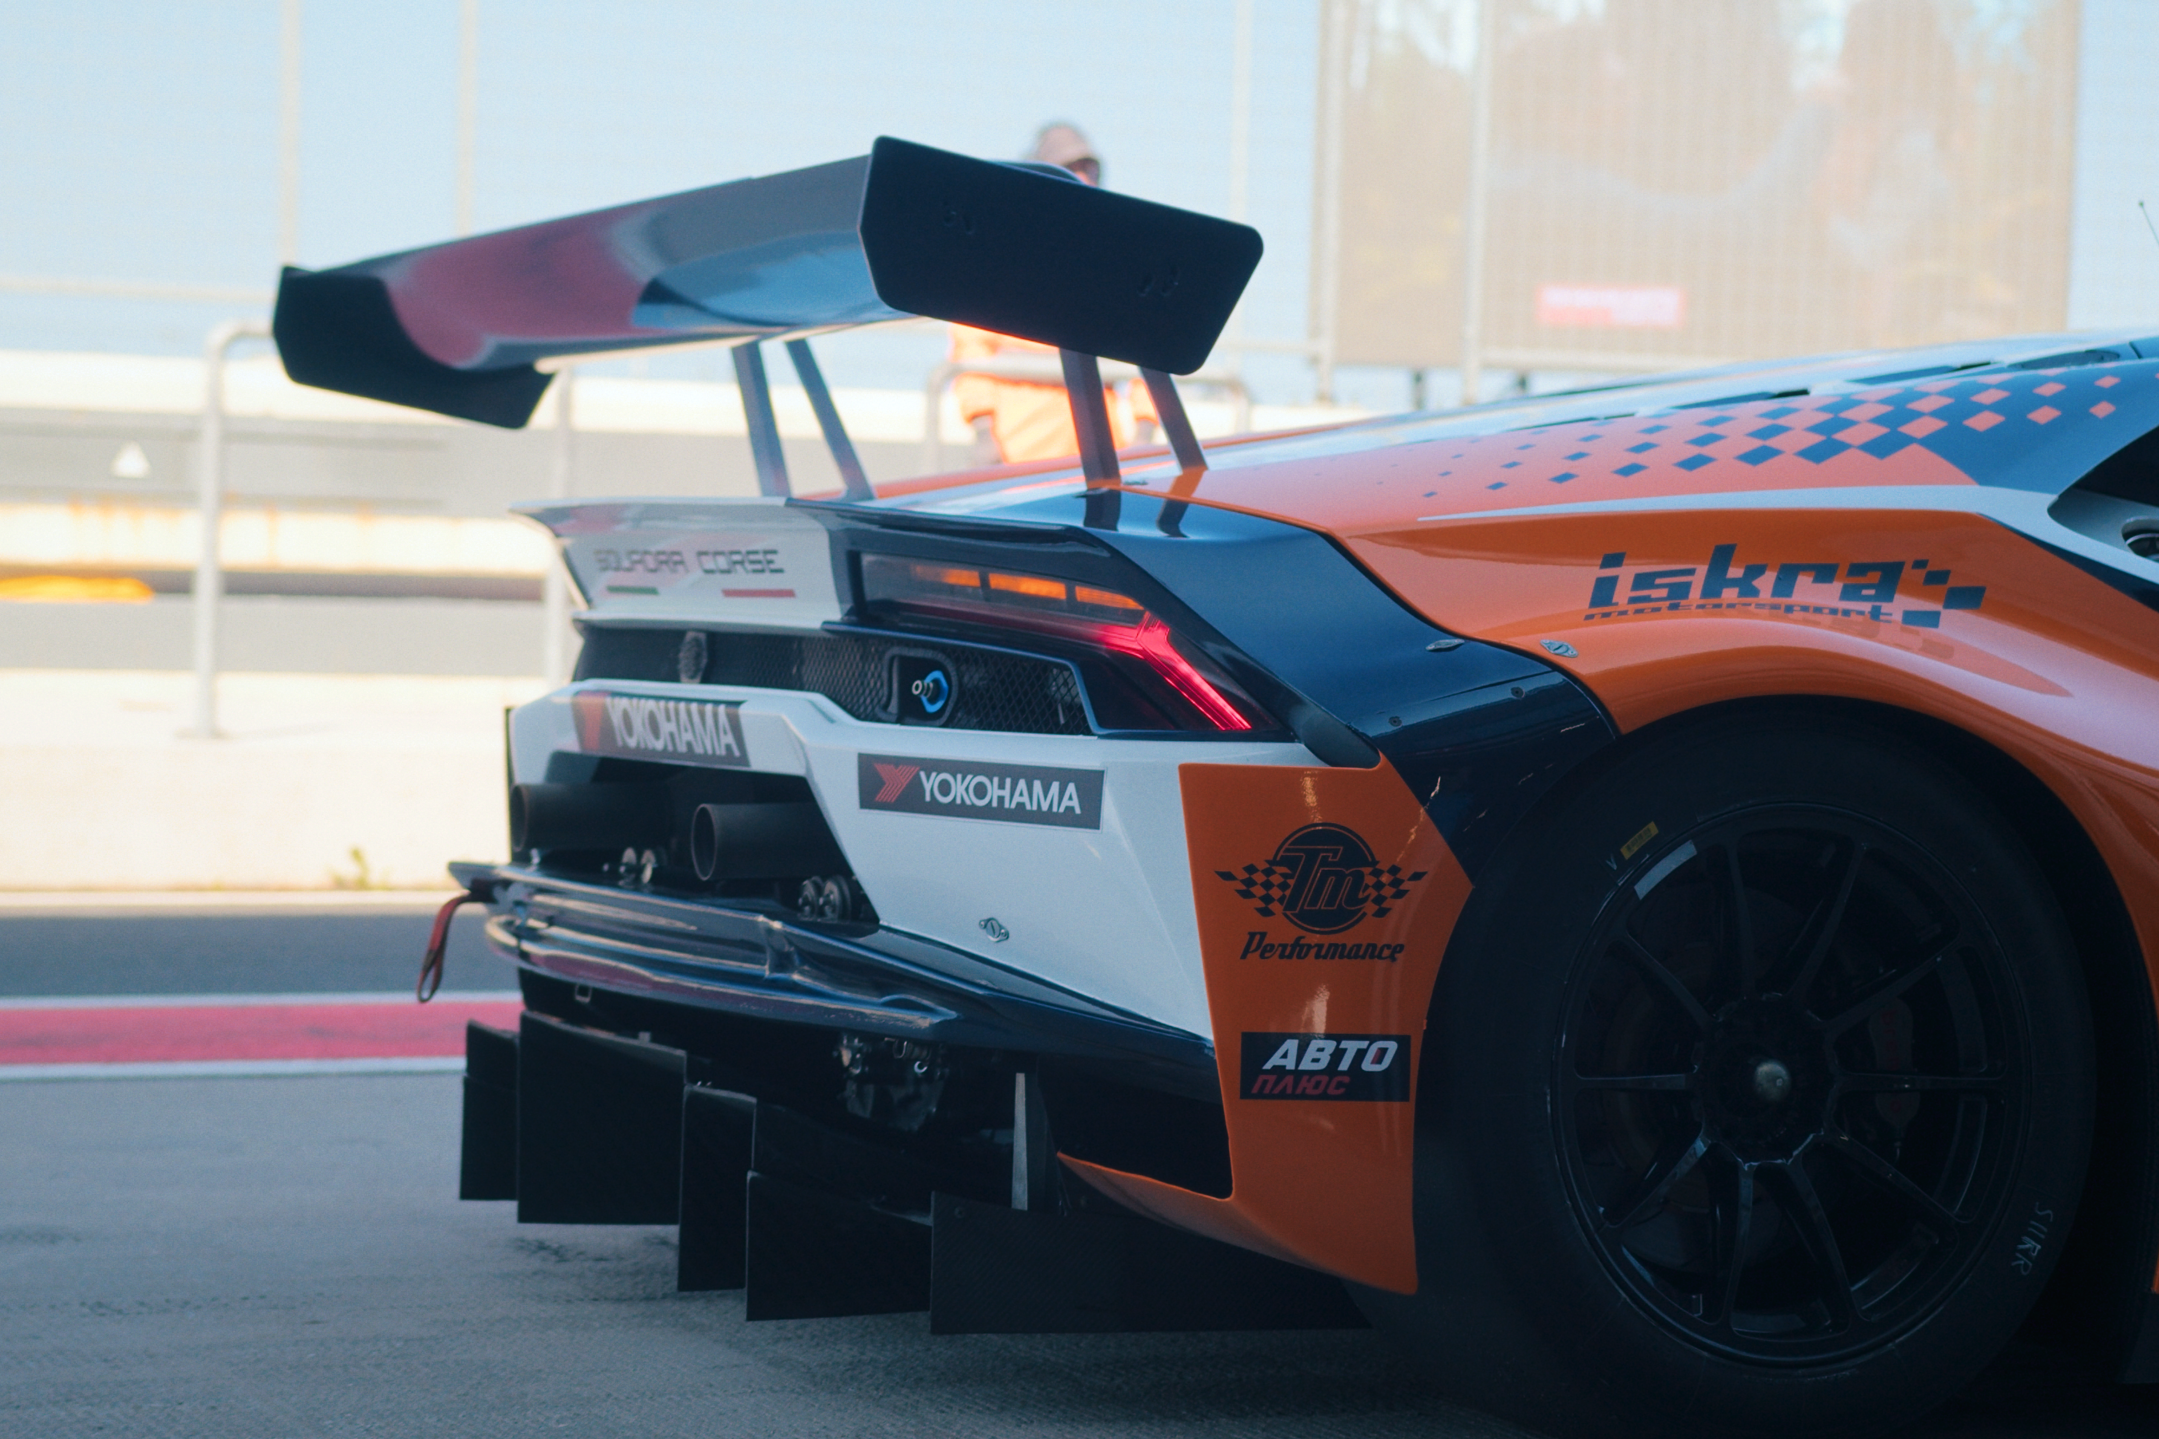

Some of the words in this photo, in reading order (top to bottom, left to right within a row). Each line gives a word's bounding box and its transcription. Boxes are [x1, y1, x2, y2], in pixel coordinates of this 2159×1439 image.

[697, 549, 784, 574] CORSE
[1588, 544, 1905, 609] iskra
[1583, 601, 1893, 624] motorsport
[606, 696, 740, 757] YOKOHAMA
[919, 771, 1082, 814] YOKOHAMA
[1239, 932, 1405, 962] Performance
[1262, 1039, 1398, 1071] АВТО
[1251, 1075, 1350, 1096] ПЛЮС
